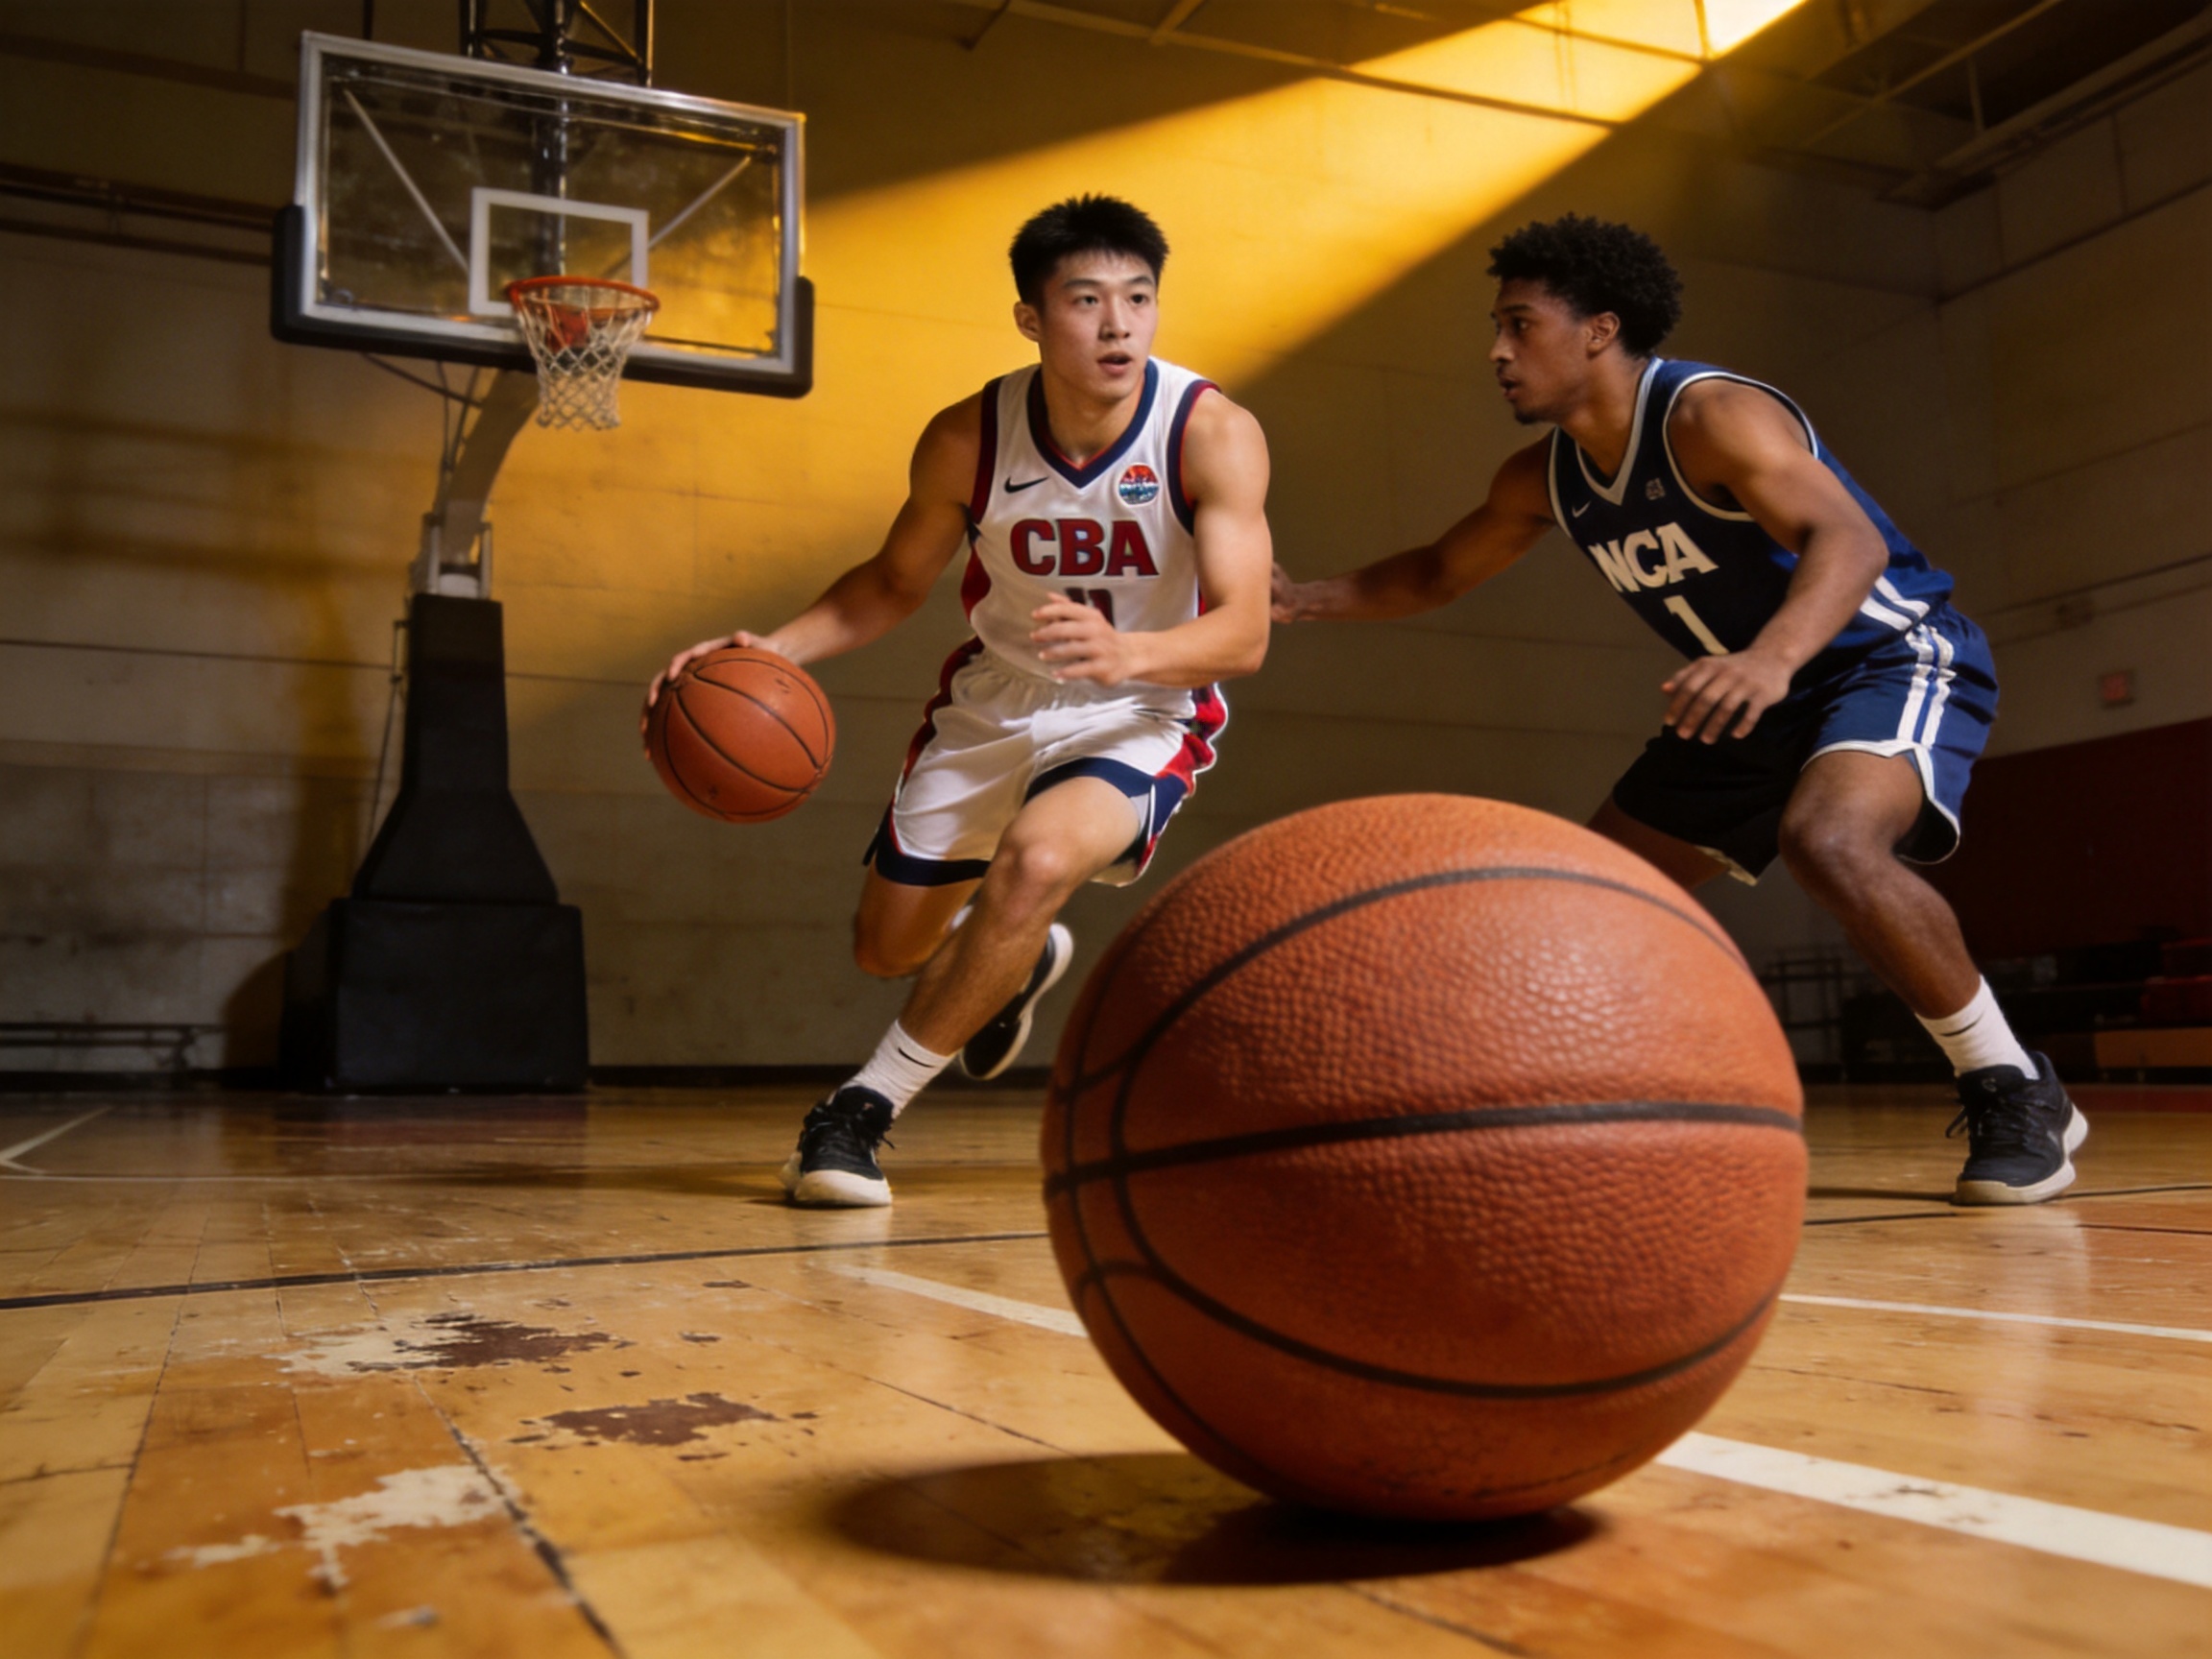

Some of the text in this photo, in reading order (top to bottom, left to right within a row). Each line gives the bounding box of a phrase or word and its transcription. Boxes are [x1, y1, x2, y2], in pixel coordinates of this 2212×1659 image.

[1010, 518, 1160, 576] CBA
[1587, 521, 1719, 593] NCA
[1663, 594, 1730, 656] 1
